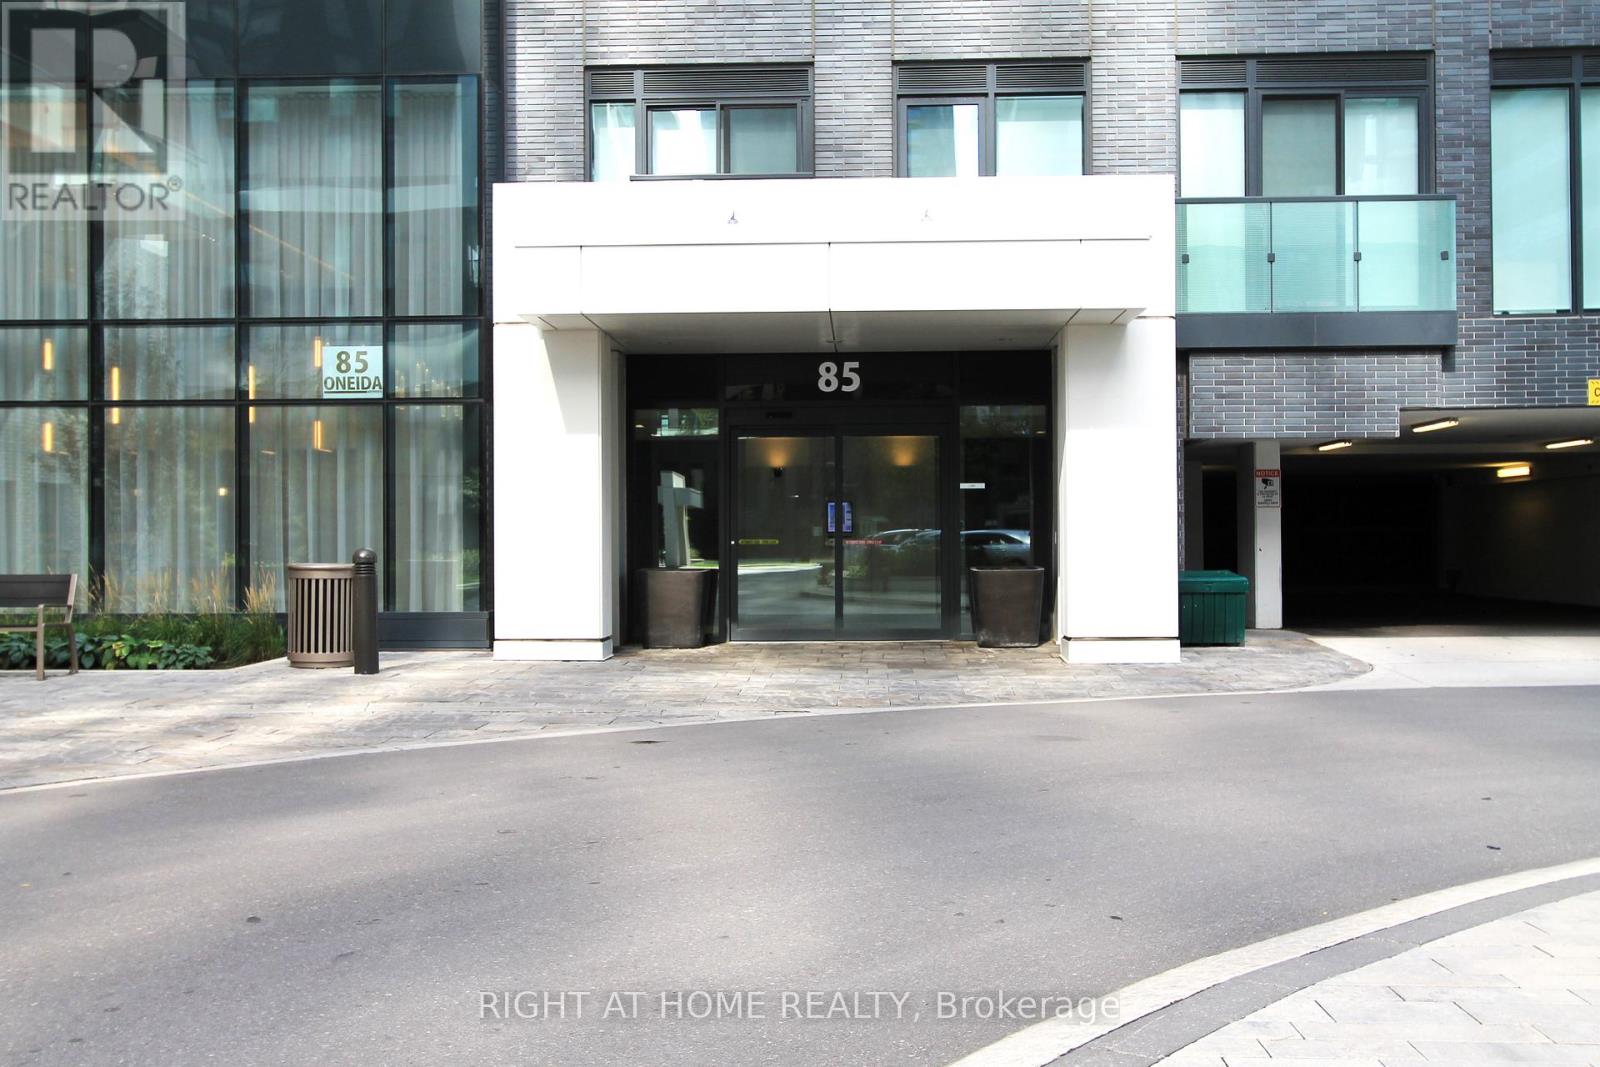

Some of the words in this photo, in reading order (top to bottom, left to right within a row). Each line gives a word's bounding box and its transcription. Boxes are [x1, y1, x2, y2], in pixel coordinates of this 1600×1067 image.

[336, 350, 369, 374] 85
[324, 376, 383, 390] ONEIDA
[818, 361, 861, 393] 85
